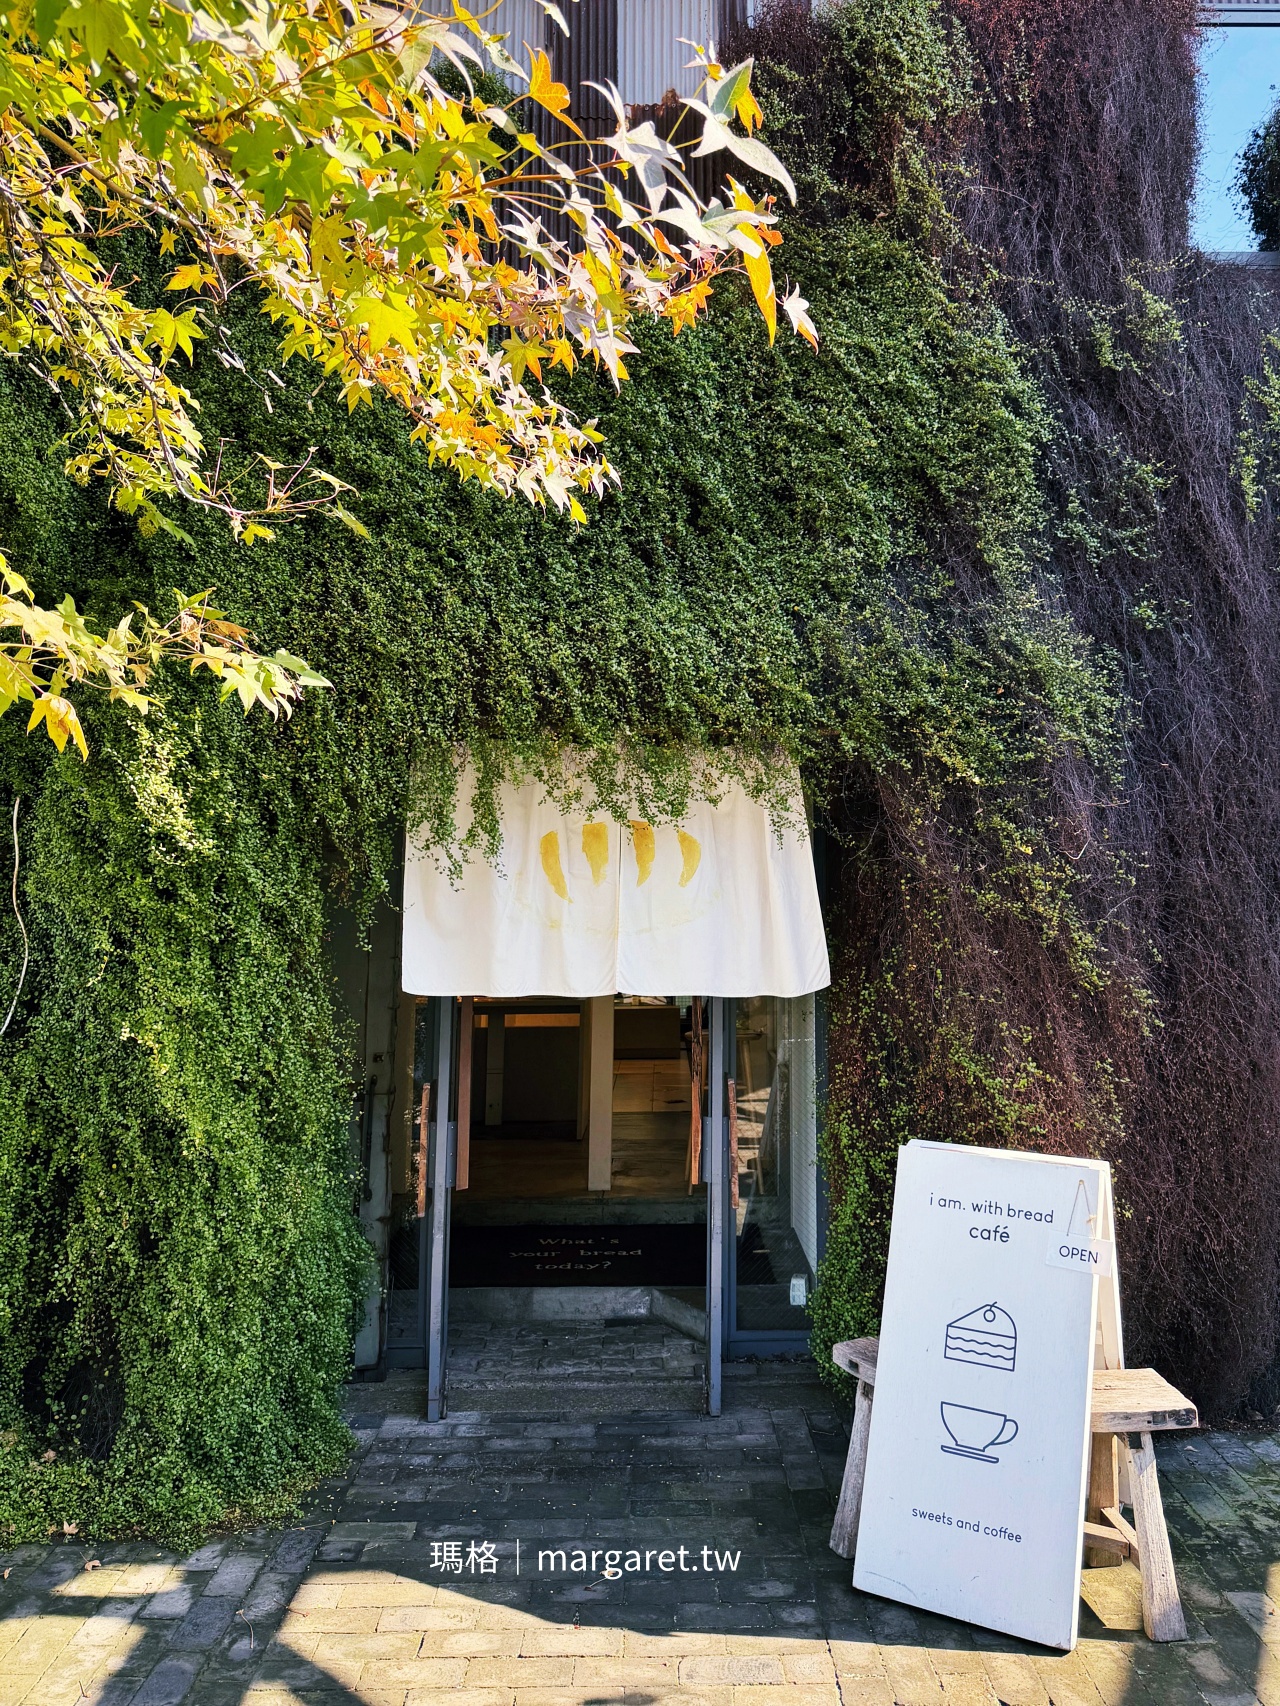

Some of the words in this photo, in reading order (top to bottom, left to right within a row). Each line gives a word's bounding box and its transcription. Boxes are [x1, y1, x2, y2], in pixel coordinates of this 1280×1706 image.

[938, 1197, 966, 1211] am.
[971, 1200, 1003, 1216] with
[1007, 1203, 1055, 1224] bread
[539, 1237, 620, 1245] What's
[969, 1225, 1010, 1243] café
[508, 1250, 561, 1258] your
[579, 1249, 642, 1257] bread
[1058, 1245, 1099, 1264] OPEN
[534, 1261, 612, 1270] today?
[911, 1507, 953, 1526] sweets
[956, 1520, 980, 1533] and
[983, 1526, 1022, 1543] coffee
